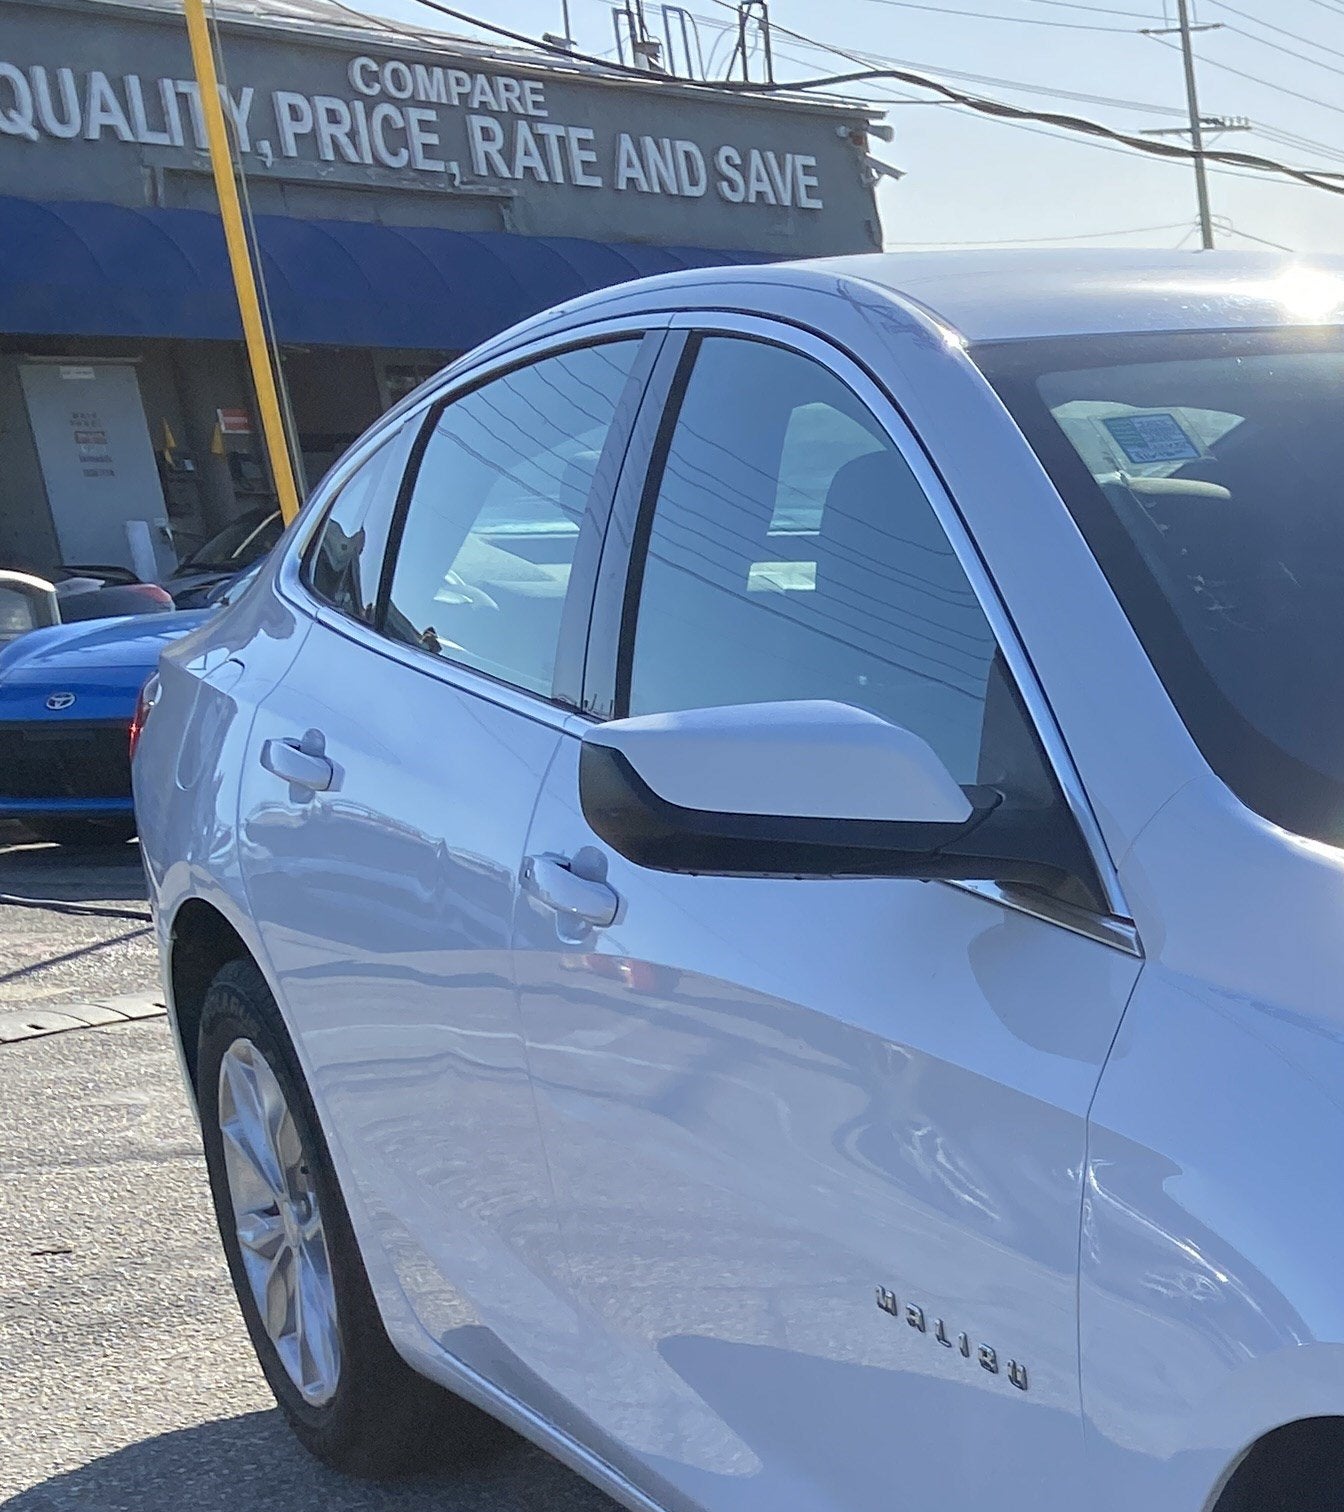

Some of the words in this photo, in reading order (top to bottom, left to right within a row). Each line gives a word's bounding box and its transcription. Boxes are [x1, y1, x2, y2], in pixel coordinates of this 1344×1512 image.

[0, 62, 274, 168] QUALITY,
[272, 91, 460, 186] PRICE,
[465, 114, 603, 188] RATE
[614, 133, 708, 197] AND
[716, 146, 823, 209] SAVE
[348, 56, 549, 117] COMPARE
